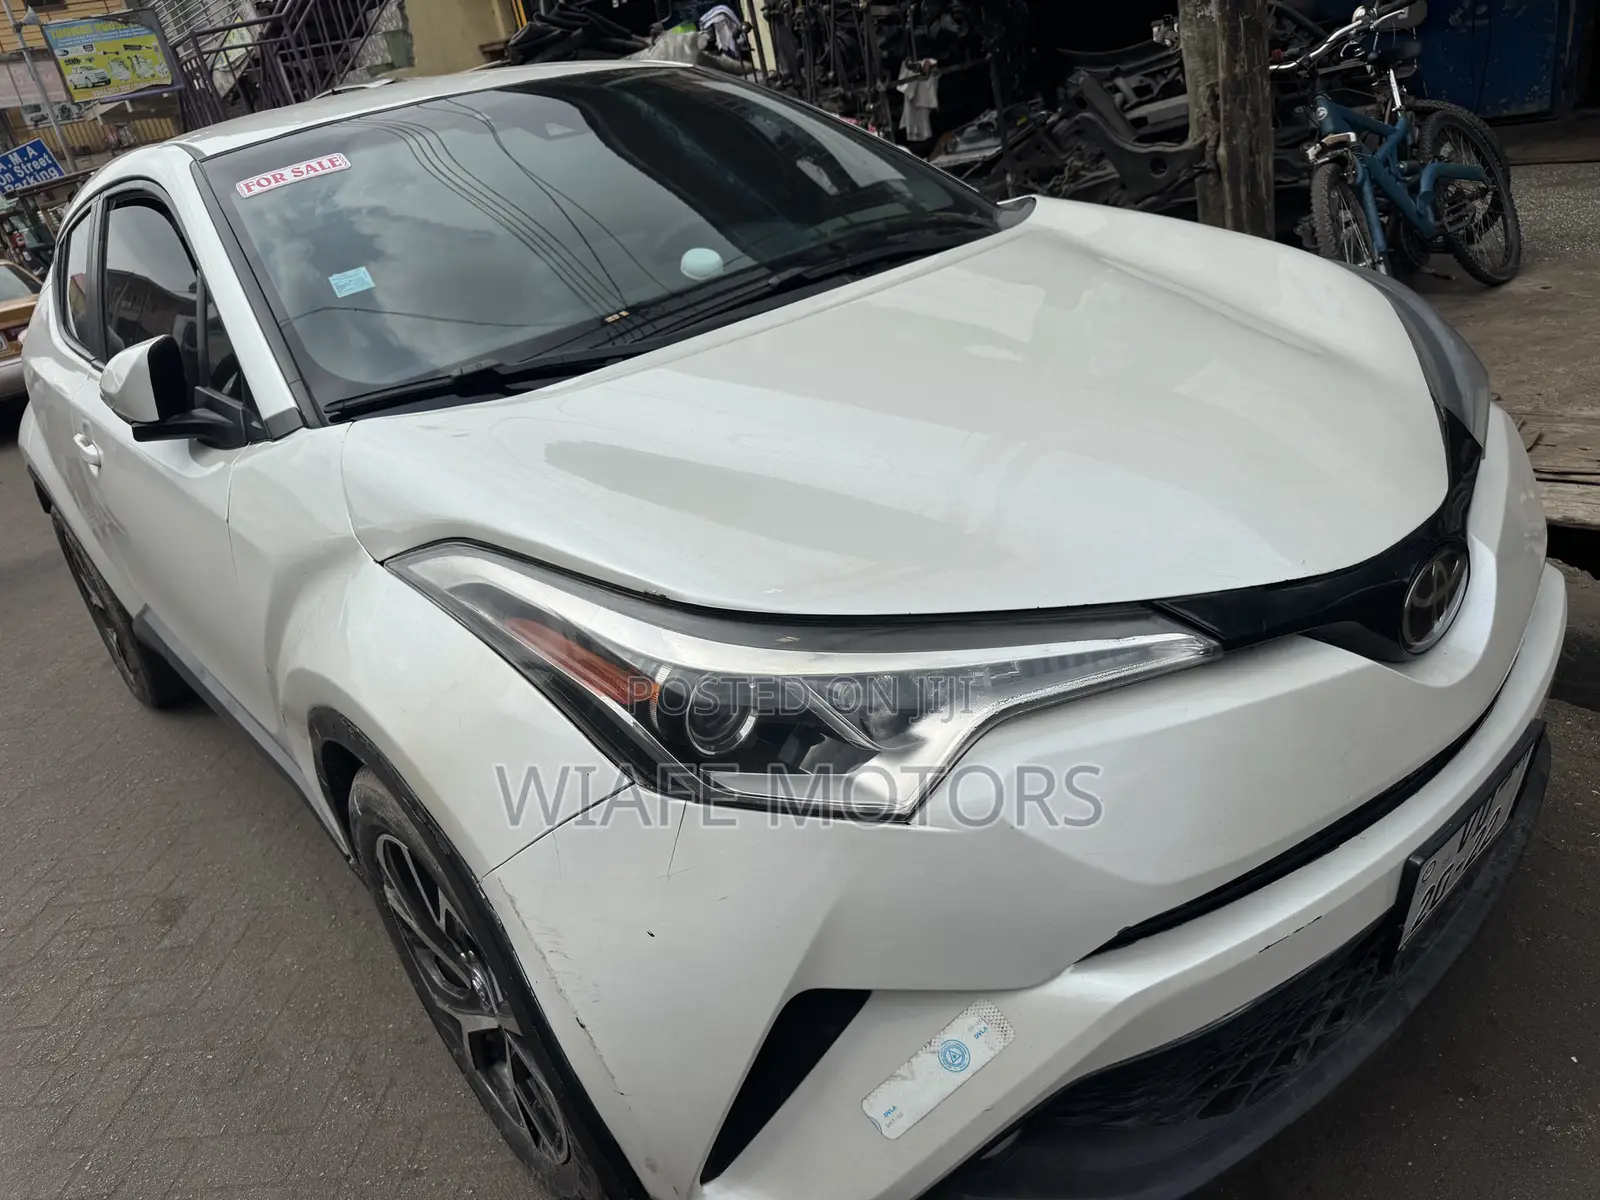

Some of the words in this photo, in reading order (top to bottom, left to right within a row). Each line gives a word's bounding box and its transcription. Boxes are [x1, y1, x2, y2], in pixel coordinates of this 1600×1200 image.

[0, 171, 14, 186] On
[13, 153, 52, 178] Street
[244, 171, 288, 194] FOR
[291, 157, 342, 178] SALE
[973, 1026, 989, 1040] DVLA
[883, 1105, 897, 1118] DVLA
